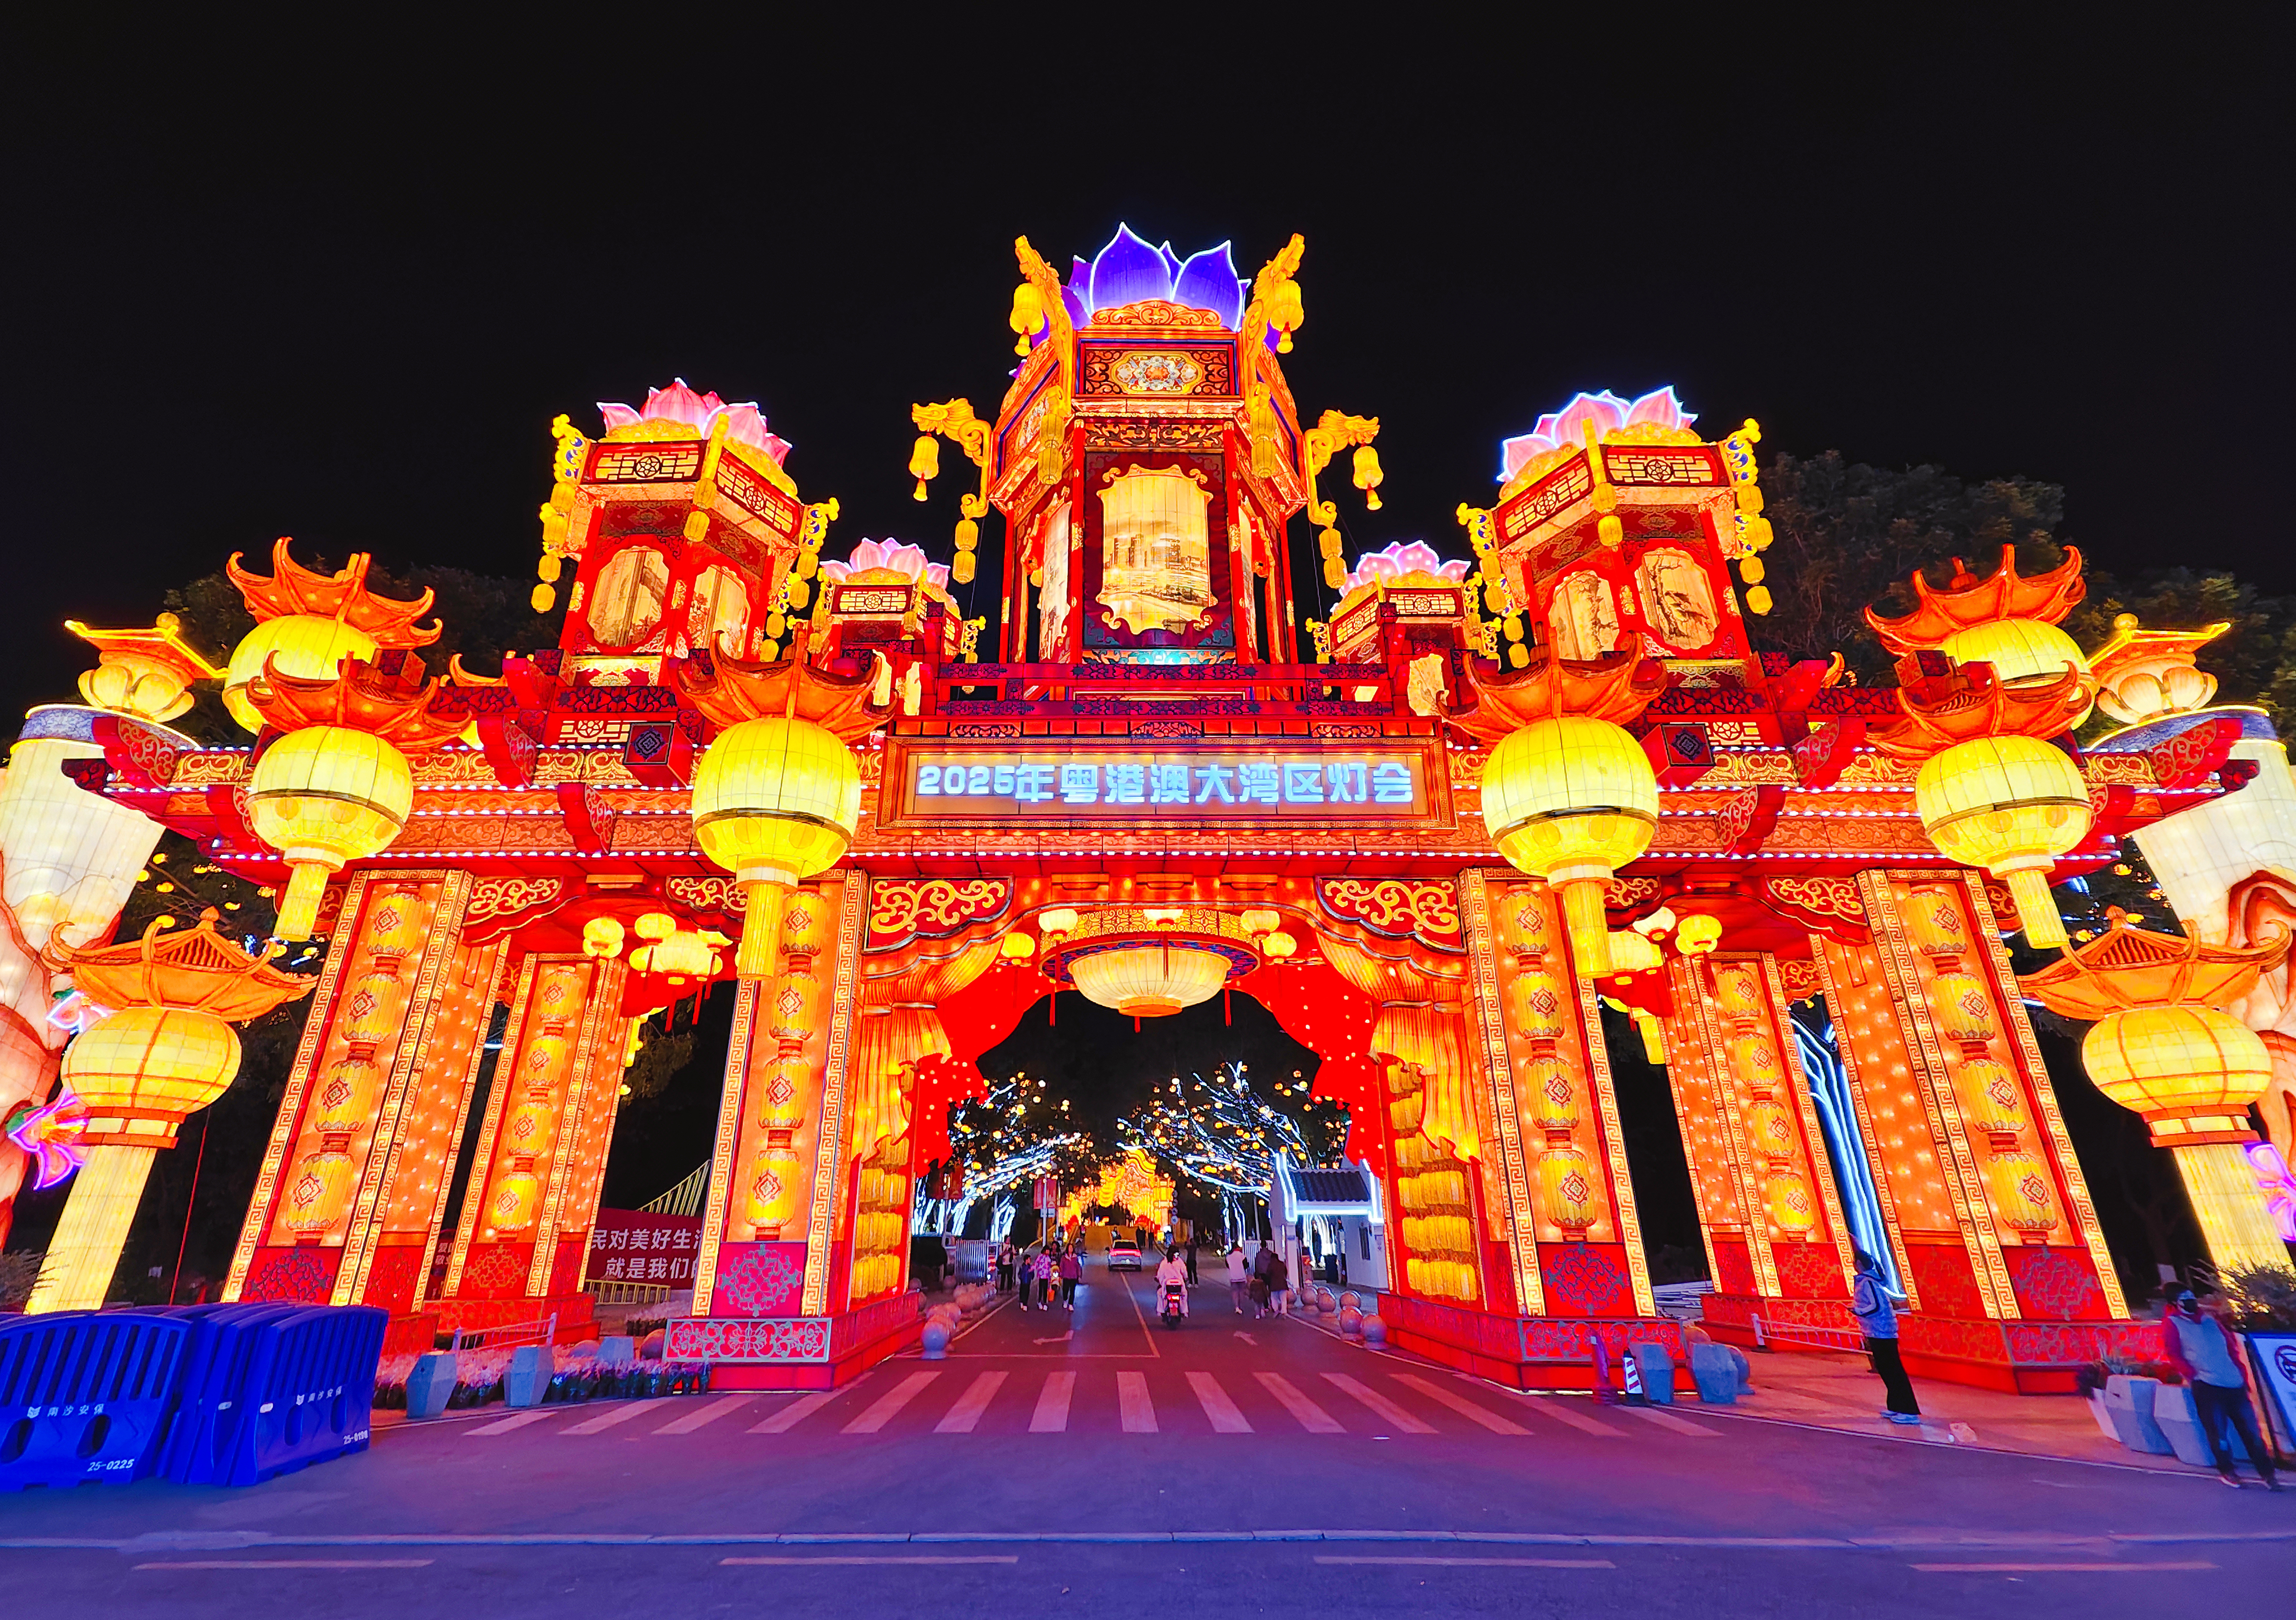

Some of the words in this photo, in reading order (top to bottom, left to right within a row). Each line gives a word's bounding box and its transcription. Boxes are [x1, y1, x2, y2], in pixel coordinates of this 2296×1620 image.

[918, 763, 1413, 803] 2025年粤港澳大湾区灯会
[87, 1458, 135, 1472] 25-0225
